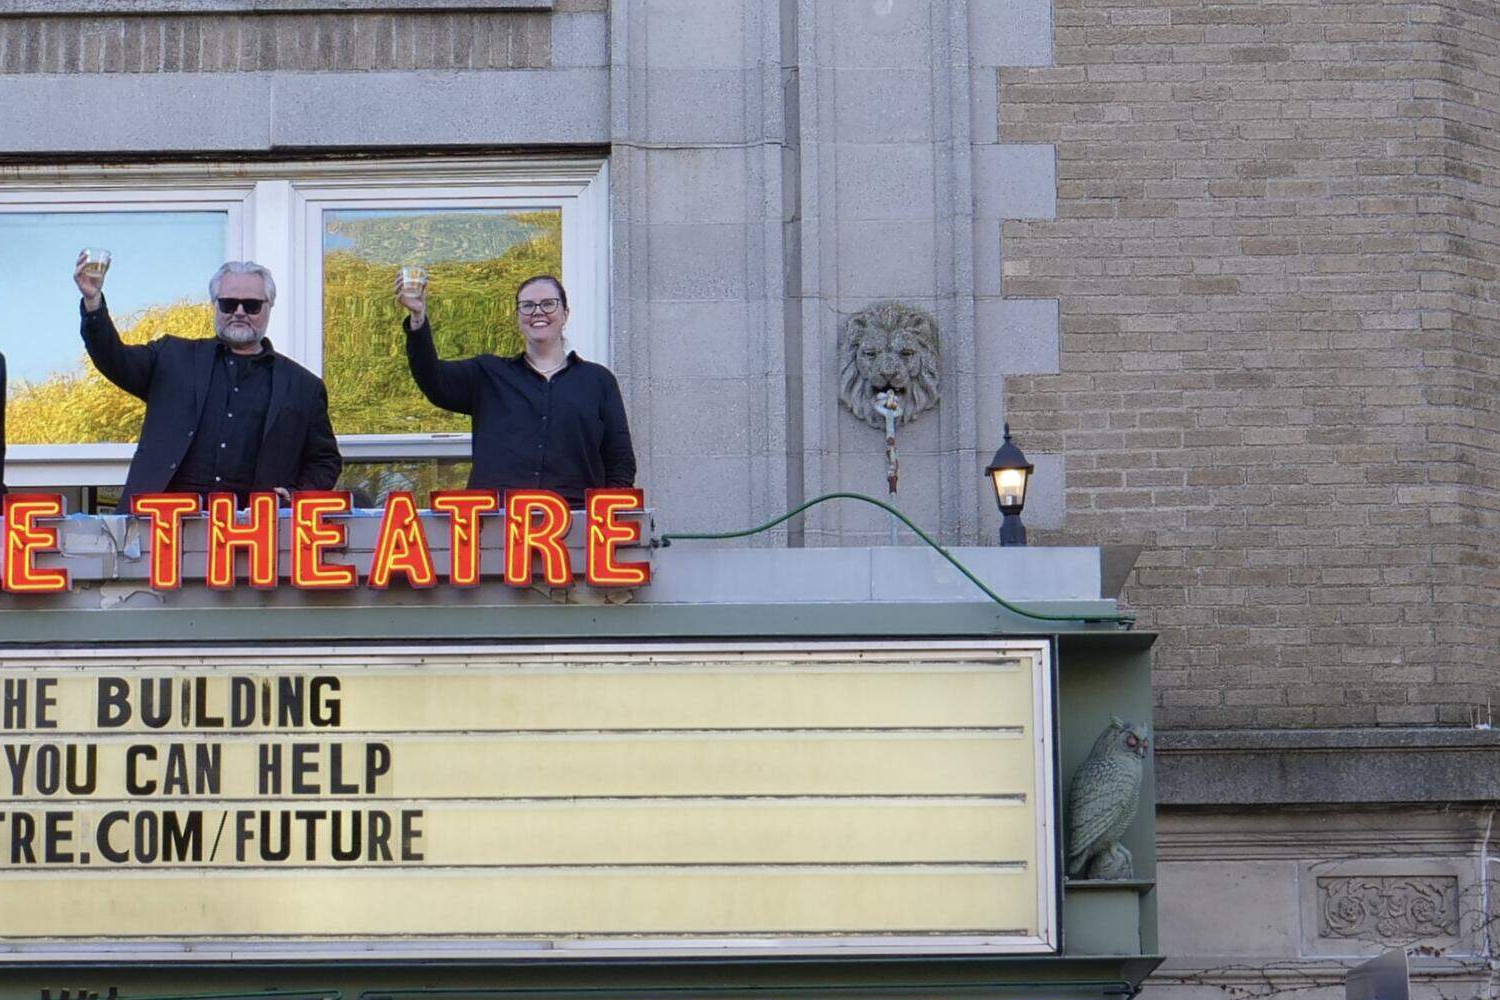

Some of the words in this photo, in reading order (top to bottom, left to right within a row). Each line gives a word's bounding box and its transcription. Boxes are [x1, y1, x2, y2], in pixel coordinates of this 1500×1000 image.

[131, 488, 652, 590] THEATRE
[97, 675, 342, 728] BUILDING
[5, 743, 98, 796] YOU
[125, 743, 222, 795] CAN
[258, 742, 392, 795] HELP
